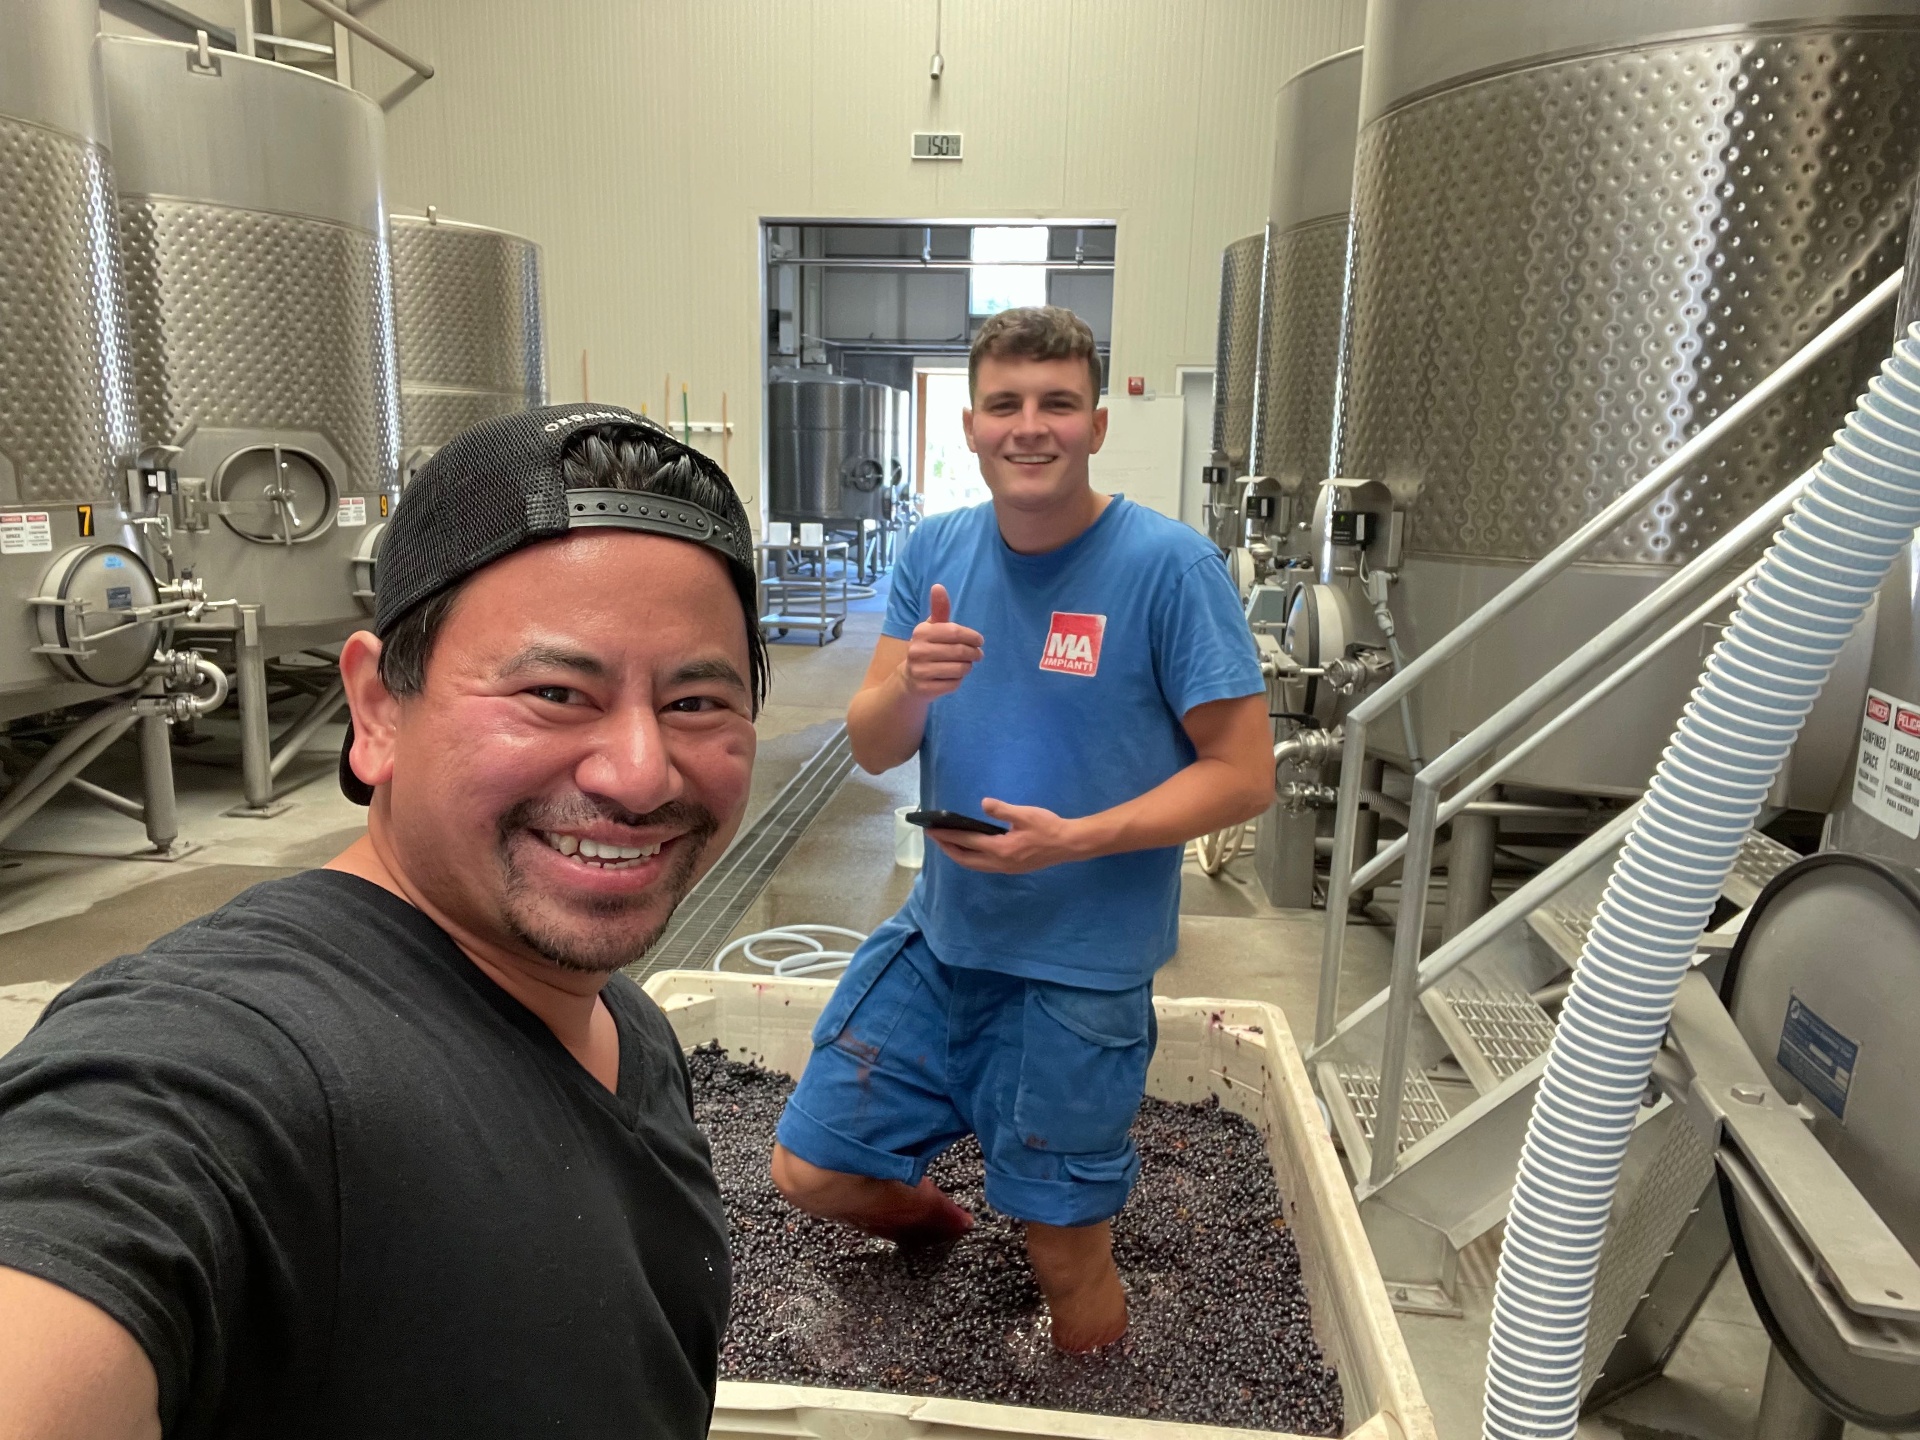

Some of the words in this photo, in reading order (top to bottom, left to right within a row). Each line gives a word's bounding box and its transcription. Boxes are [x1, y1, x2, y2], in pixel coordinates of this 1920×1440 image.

[928, 135, 950, 156] 150
[381, 495, 388, 516] 9
[79, 506, 91, 536] 7
[1047, 632, 1094, 663] MA
[1043, 657, 1093, 672] IMPIANTI
[1863, 728, 1887, 751] CONFINED
[1863, 751, 1879, 770] SPACE
[1896, 743, 1920, 762] ESPACIO
